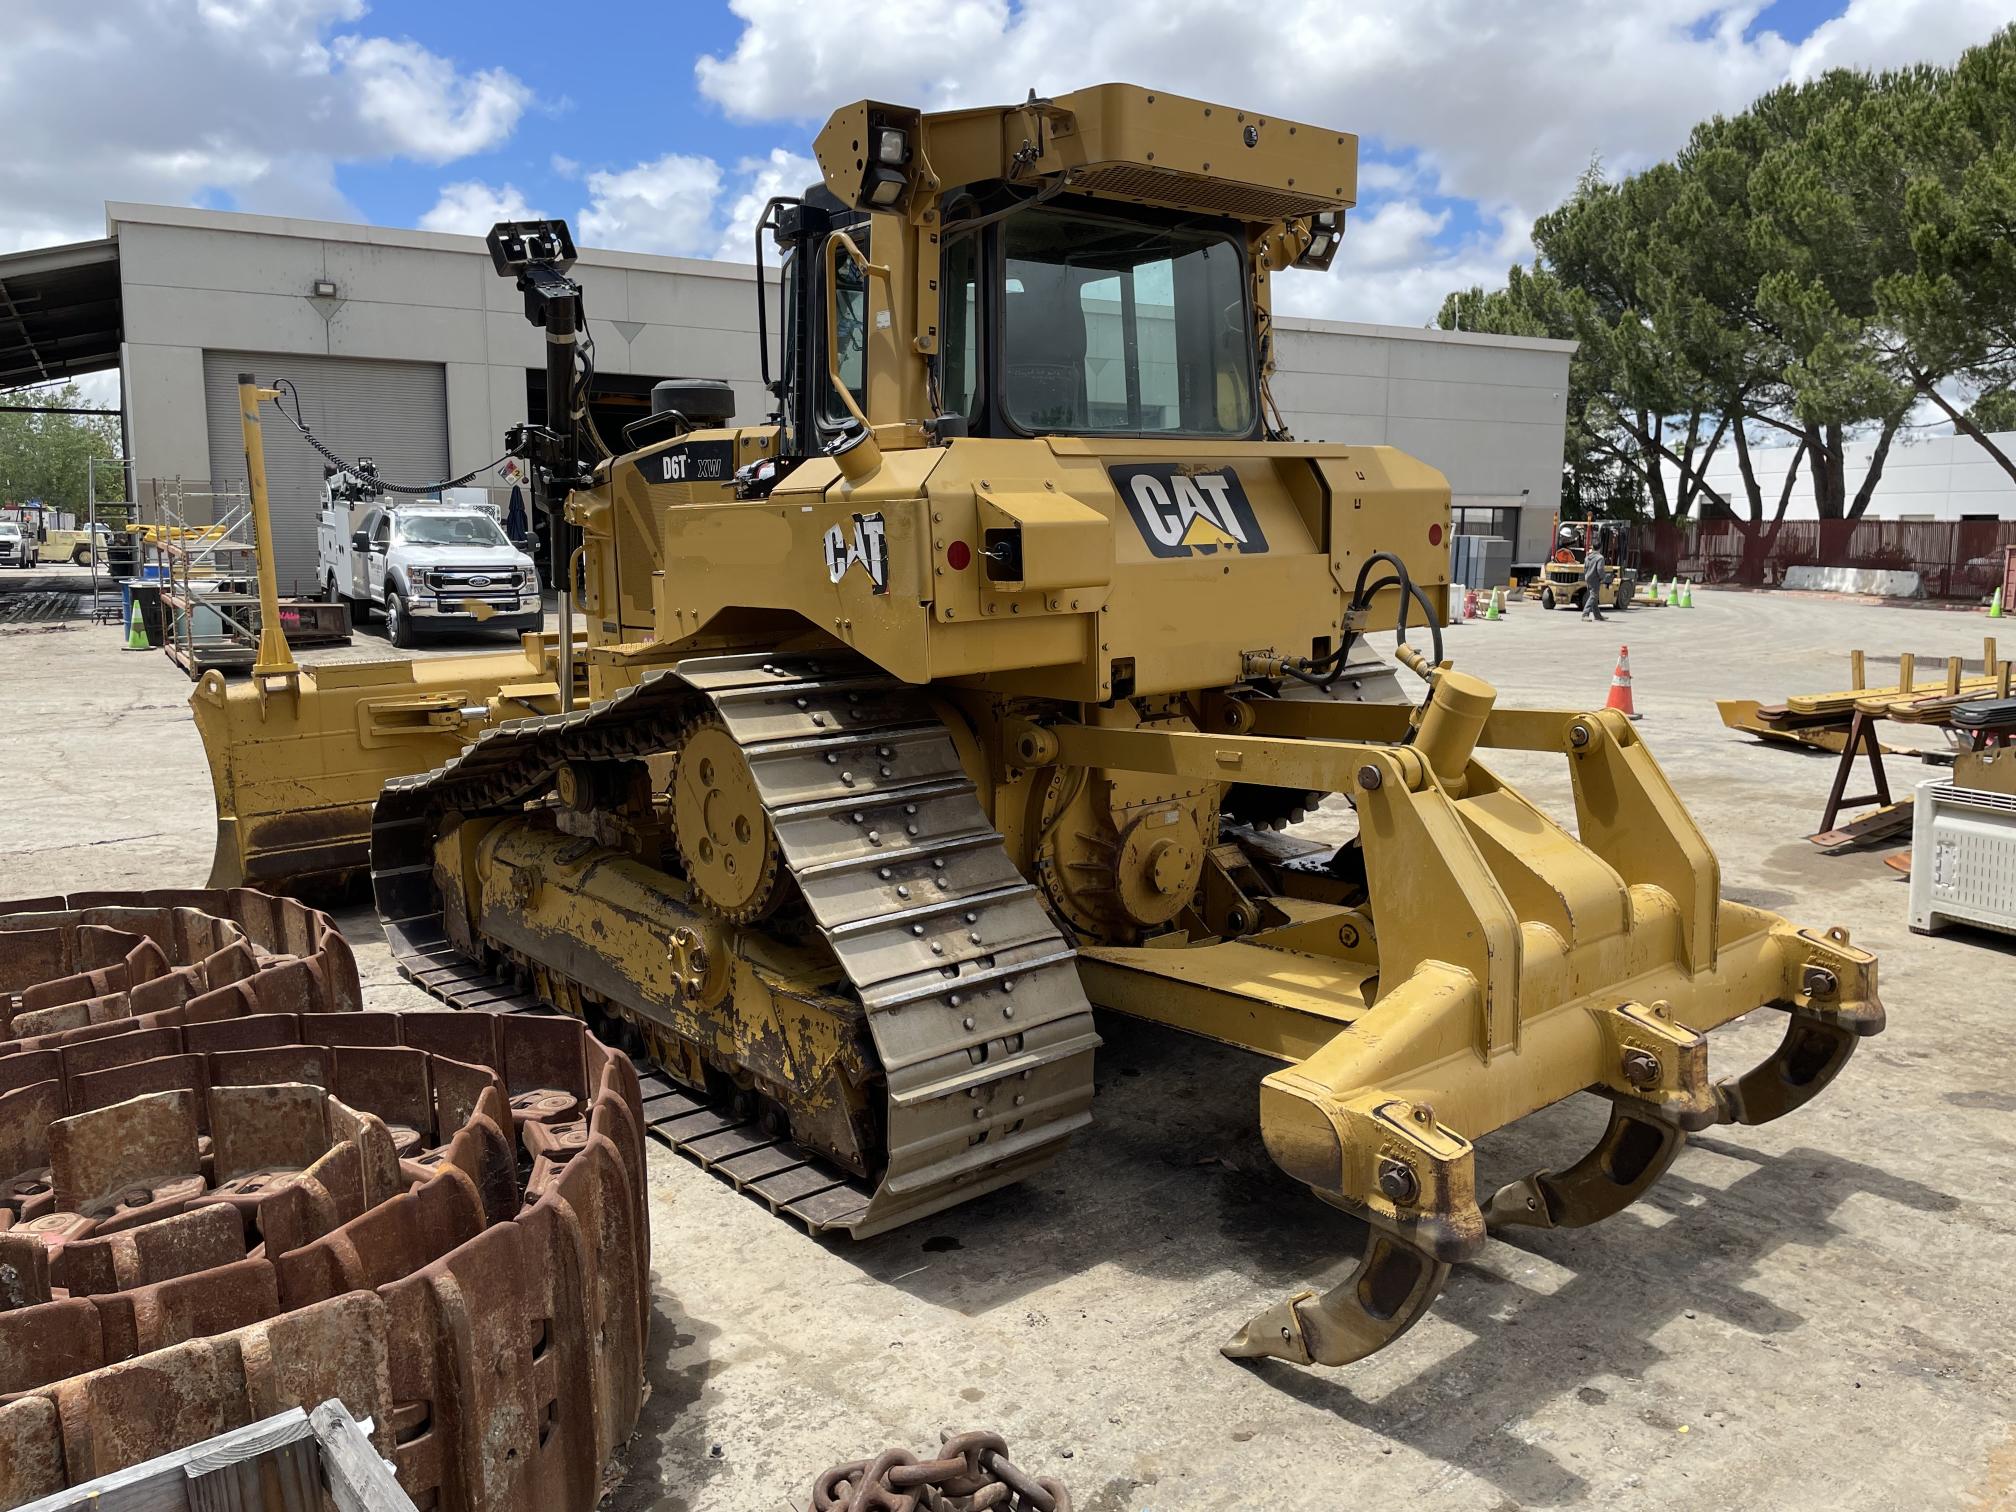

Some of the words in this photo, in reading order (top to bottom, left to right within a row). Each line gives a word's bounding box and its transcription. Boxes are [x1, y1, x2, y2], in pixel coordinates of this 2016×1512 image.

[662, 454, 687, 479] D6T
[698, 459, 721, 478] XW
[1130, 474, 1248, 547] CAT
[824, 521, 885, 585] CAT
